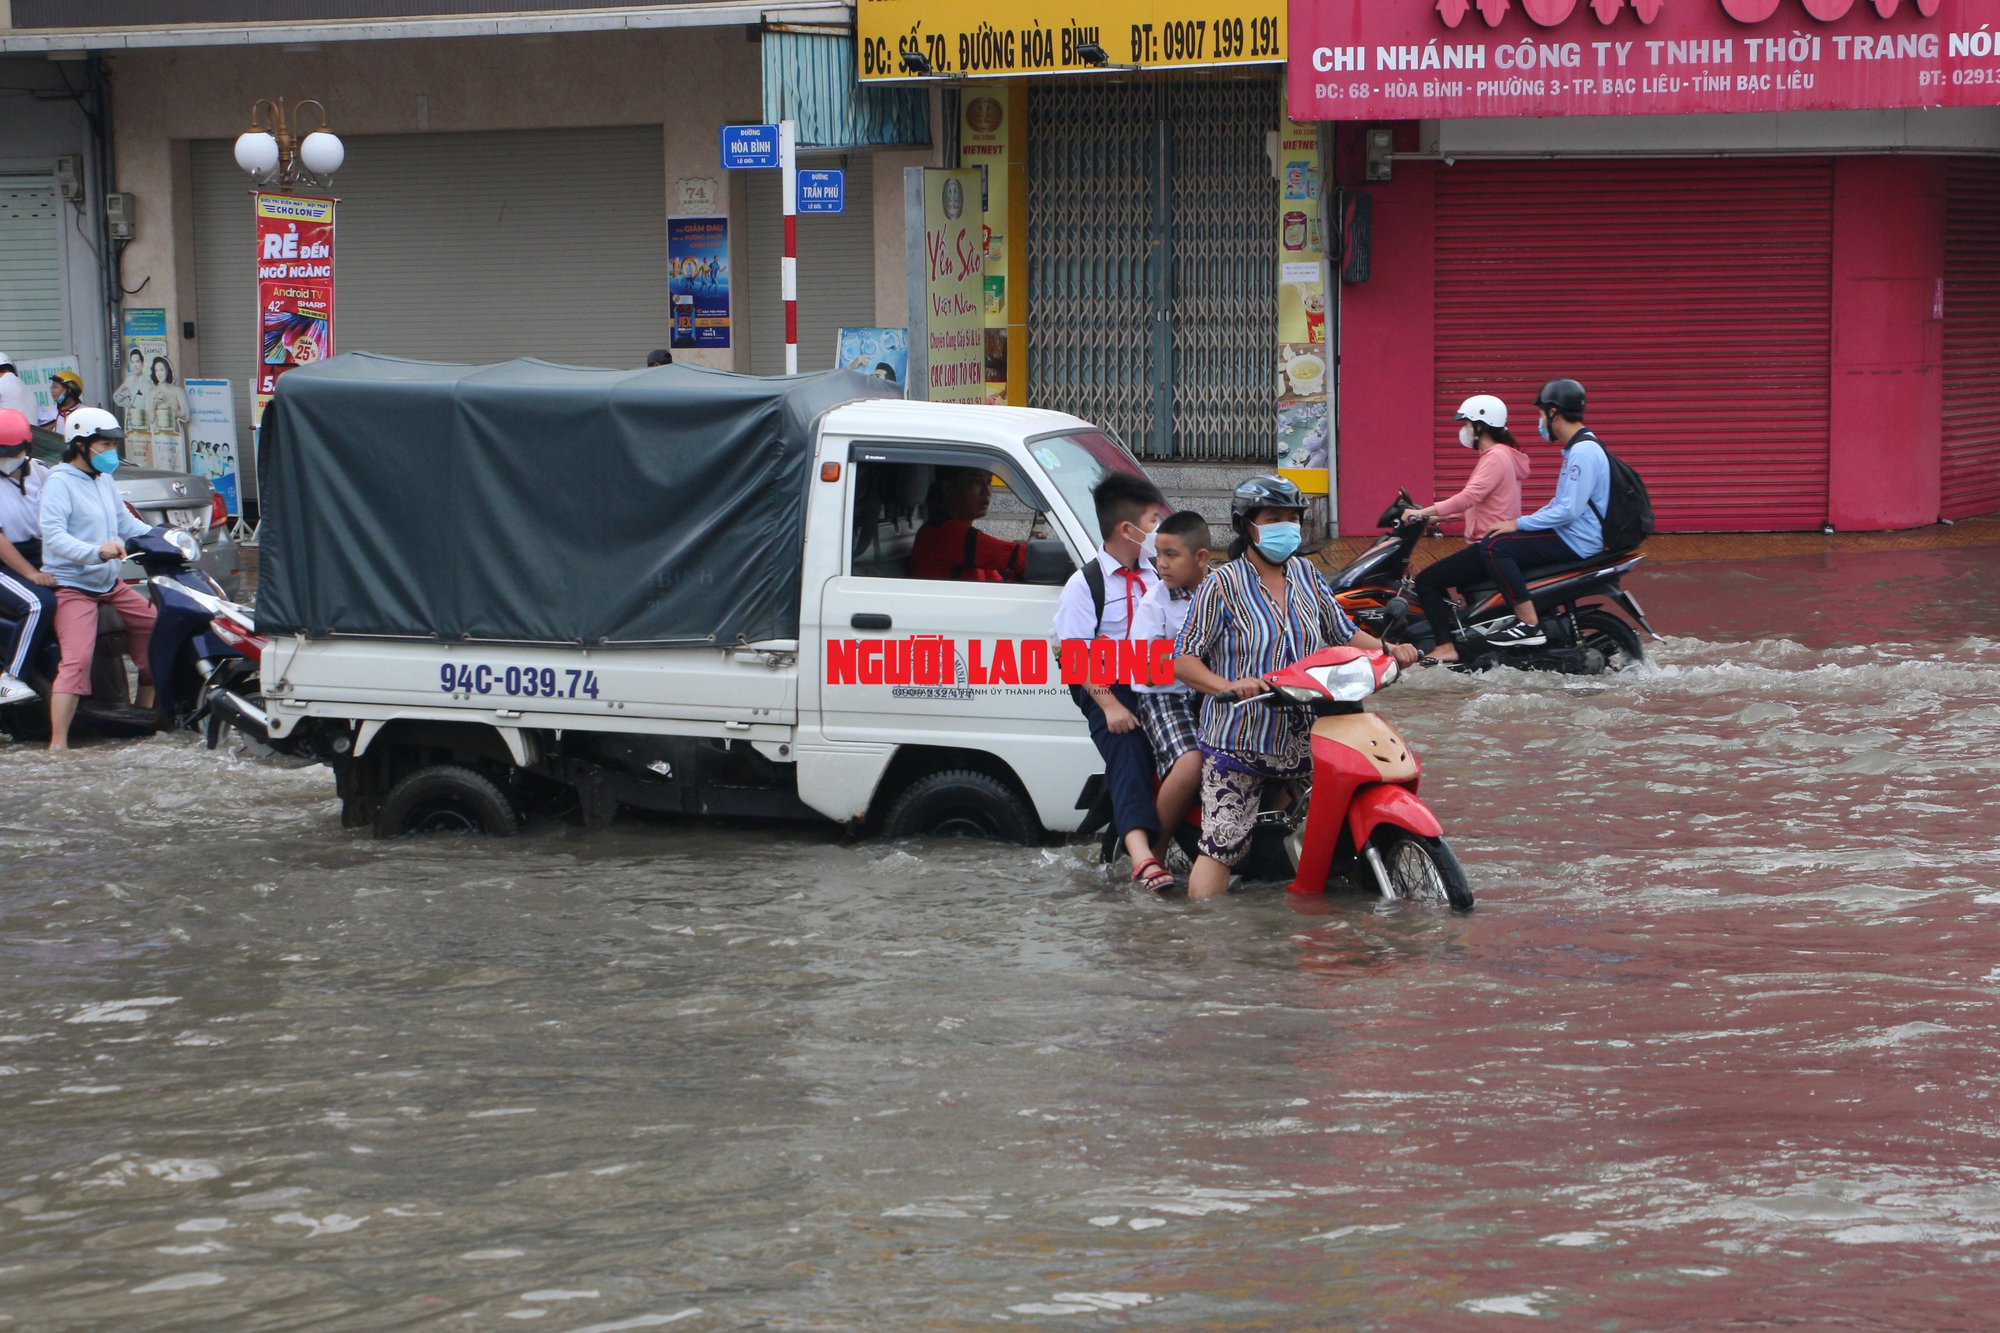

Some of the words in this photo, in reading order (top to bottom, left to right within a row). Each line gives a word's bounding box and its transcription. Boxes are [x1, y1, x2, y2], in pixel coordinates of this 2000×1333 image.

[864, 37, 892, 74] ĐC:
[959, 21, 1015, 70] ĐƯỜNG
[1021, 19, 1054, 67] HÒA
[1062, 18, 1099, 65] BÌNH
[1131, 24, 1157, 62] ĐT:
[1163, 20, 1206, 60] 0907
[1213, 17, 1244, 58] 199
[1251, 16, 1279, 56] 191
[1312, 47, 1366, 71] CHI
[1376, 38, 1486, 70] NHÁNH
[1494, 37, 1581, 69] CÔNG
[1592, 41, 1633, 66] TY
[1645, 39, 1733, 65] TNHH
[1744, 31, 1820, 63] THỜI
[1832, 33, 1939, 60] TRANG
[1948, 24, 2000, 57] NÓ
[1315, 83, 1344, 99] ĐC:
[1349, 83, 1370, 98] 68
[1384, 78, 1418, 97] HÒA
[1423, 77, 1463, 97] BÌNH
[1477, 76, 1545, 96] PHƯỜNG
[1550, 80, 1560, 95] 3
[1572, 79, 1597, 94] TP.
[1602, 78, 1636, 97] BẠC
[1643, 74, 1680, 93] LIÊU
[1692, 70, 1731, 92] TỈNH
[1737, 75, 1770, 94] BẠC
[1776, 70, 1814, 89] LIÊU
[1919, 70, 1946, 85] ĐT:
[740, 128, 760, 136] ĐƯỜNG
[731, 140, 748, 153] HÒA
[751, 139, 770, 153] BÌNH
[962, 145, 1003, 155] VIETNEST
[686, 187, 706, 199] 74
[824, 184, 839, 198] PHÚ
[263, 223, 299, 259] RẺ
[300, 241, 329, 259] ĐẾN
[927, 223, 954, 281] Yến
[957, 227, 980, 281] Sào
[259, 263, 288, 278] NGỠ
[289, 262, 331, 278] NGÀNG
[273, 287, 309, 298] Android
[311, 289, 323, 299] TV
[297, 300, 327, 309] SHARP
[954, 291, 977, 317] Nam
[931, 362, 943, 388] CÁC
[944, 363, 958, 391] LOẠI
[440, 663, 599, 699] 94C-039.74
[954, 659, 967, 684] MINH
